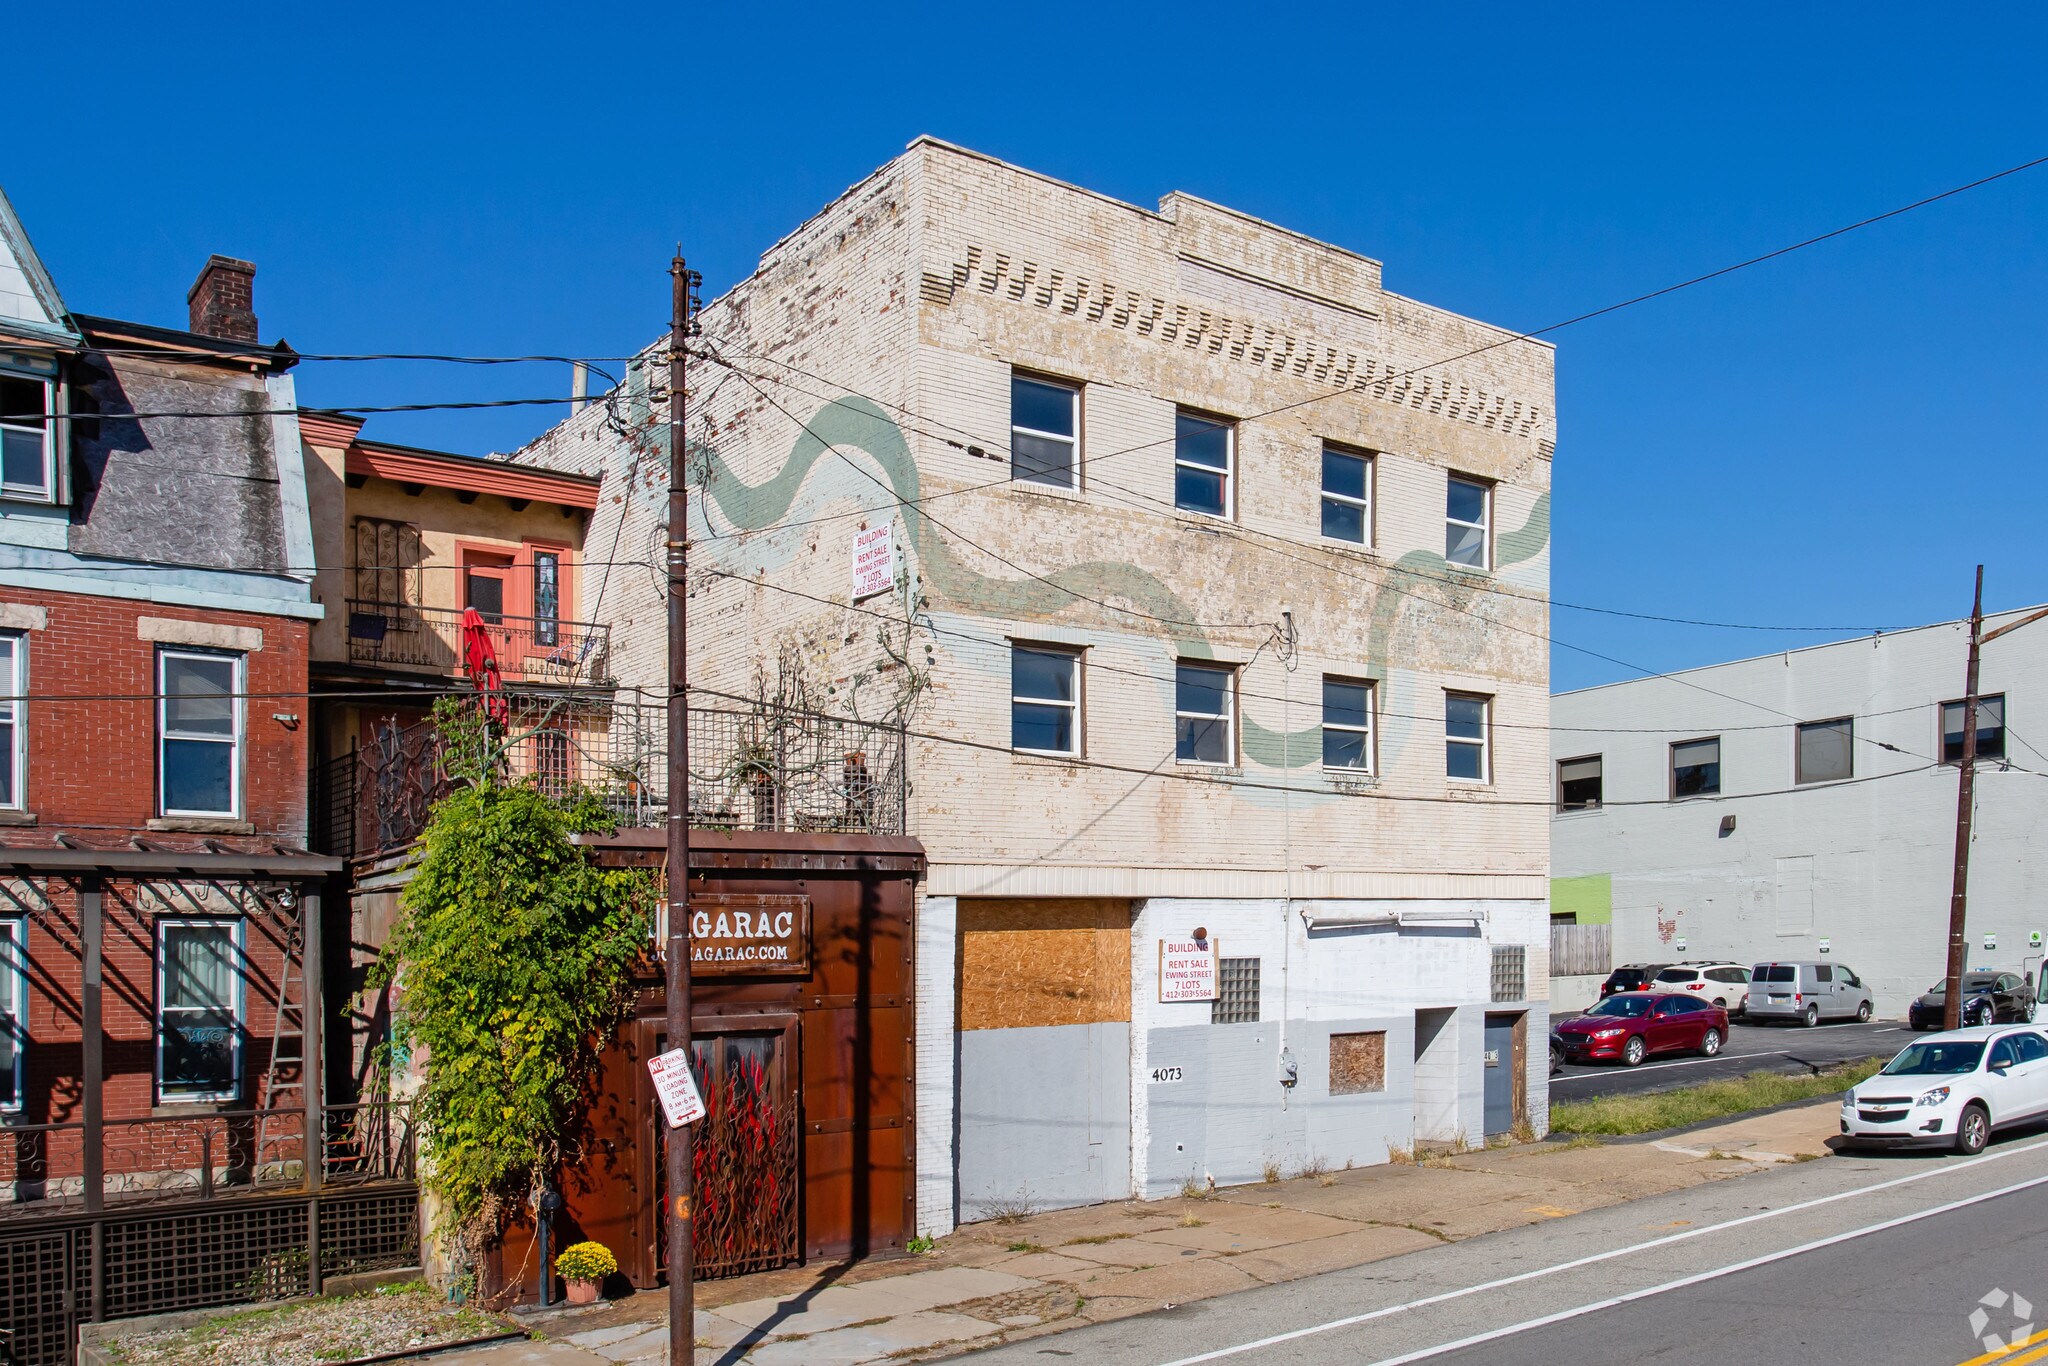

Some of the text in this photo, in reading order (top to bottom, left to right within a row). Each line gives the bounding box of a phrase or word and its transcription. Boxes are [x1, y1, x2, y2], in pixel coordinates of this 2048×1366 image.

[857, 525, 888, 547] BUILDING
[857, 544, 887, 564] RENT SALE
[856, 554, 891, 576] EWING STREET
[867, 569, 882, 583] LOTS
[855, 576, 891, 596] 412-303-5564
[1168, 943, 1209, 953] BUILDING
[1168, 959, 1209, 969] RENT SALE
[1165, 970, 1212, 979] EWING STREET
[1175, 980, 1201, 989] 7 LOTS
[650, 1053, 684, 1072] NO PARKING
[657, 1066, 688, 1084] 30 MINUTE
[1152, 1067, 1182, 1081] 4073
[663, 1076, 688, 1092] LOADING
[670, 1087, 688, 1099] ZONE
[688, 1095, 696, 1103] PM
